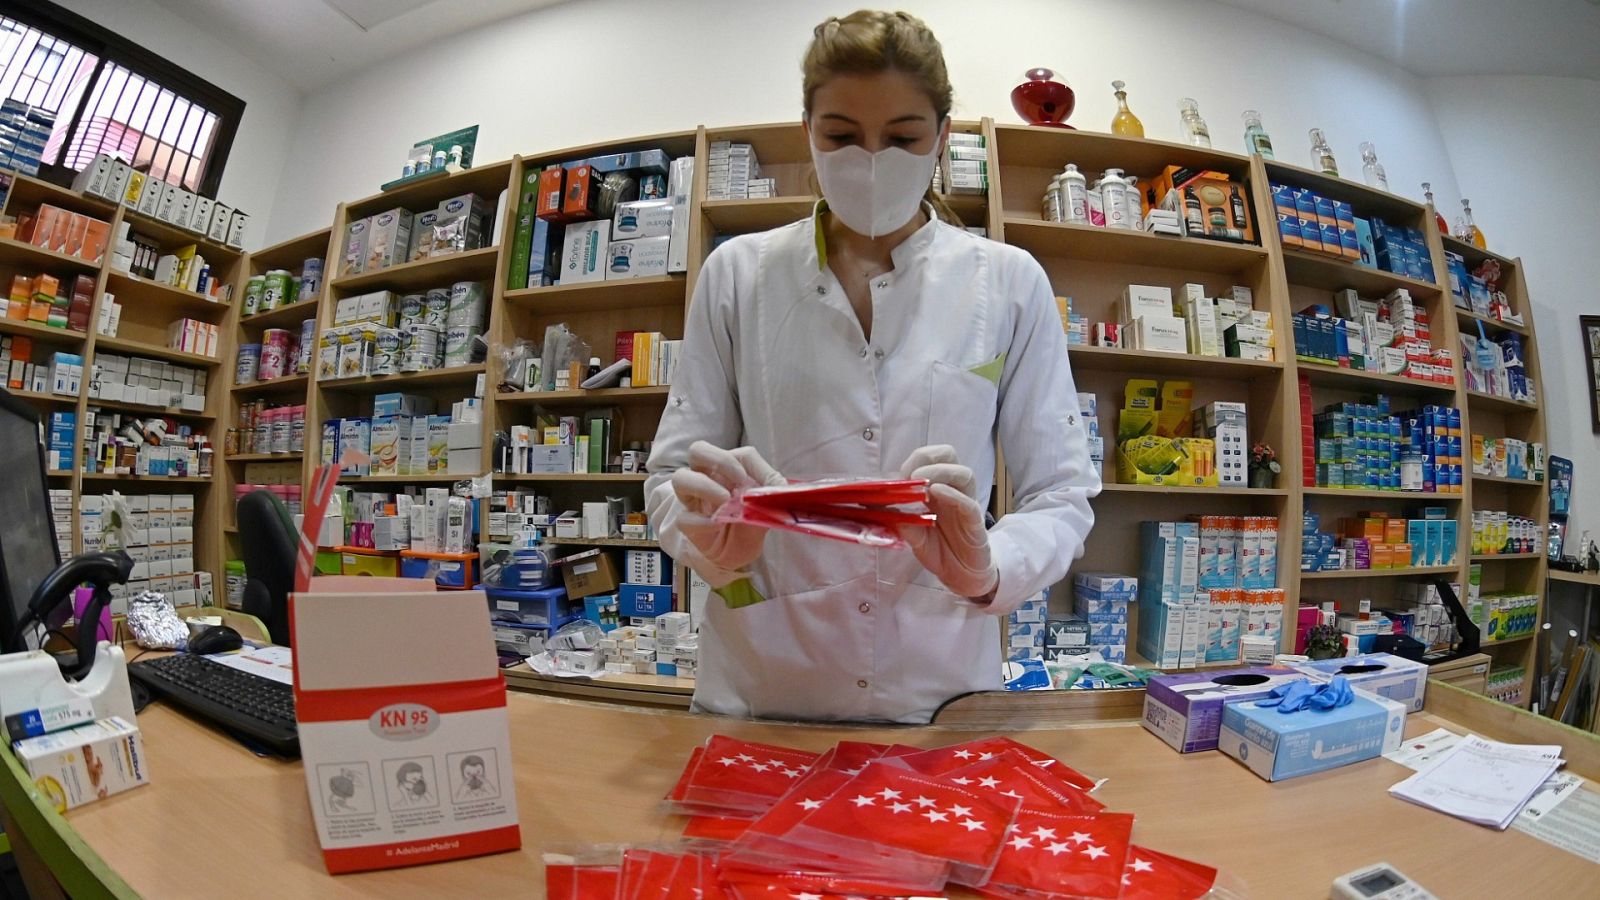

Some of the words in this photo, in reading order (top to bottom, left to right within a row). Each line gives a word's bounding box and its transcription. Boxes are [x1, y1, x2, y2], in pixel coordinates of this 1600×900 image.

[247, 296, 255, 308] 3
[265, 289, 273, 301] 3
[430, 312, 439, 326] 2
[271, 355, 280, 369] 2
[379, 353, 391, 369] 2
[380, 709, 406, 727] KN
[411, 710, 429, 725] 95
[128, 735, 142, 780] Halibut
[395, 840, 460, 857] AdelanteMadrid
